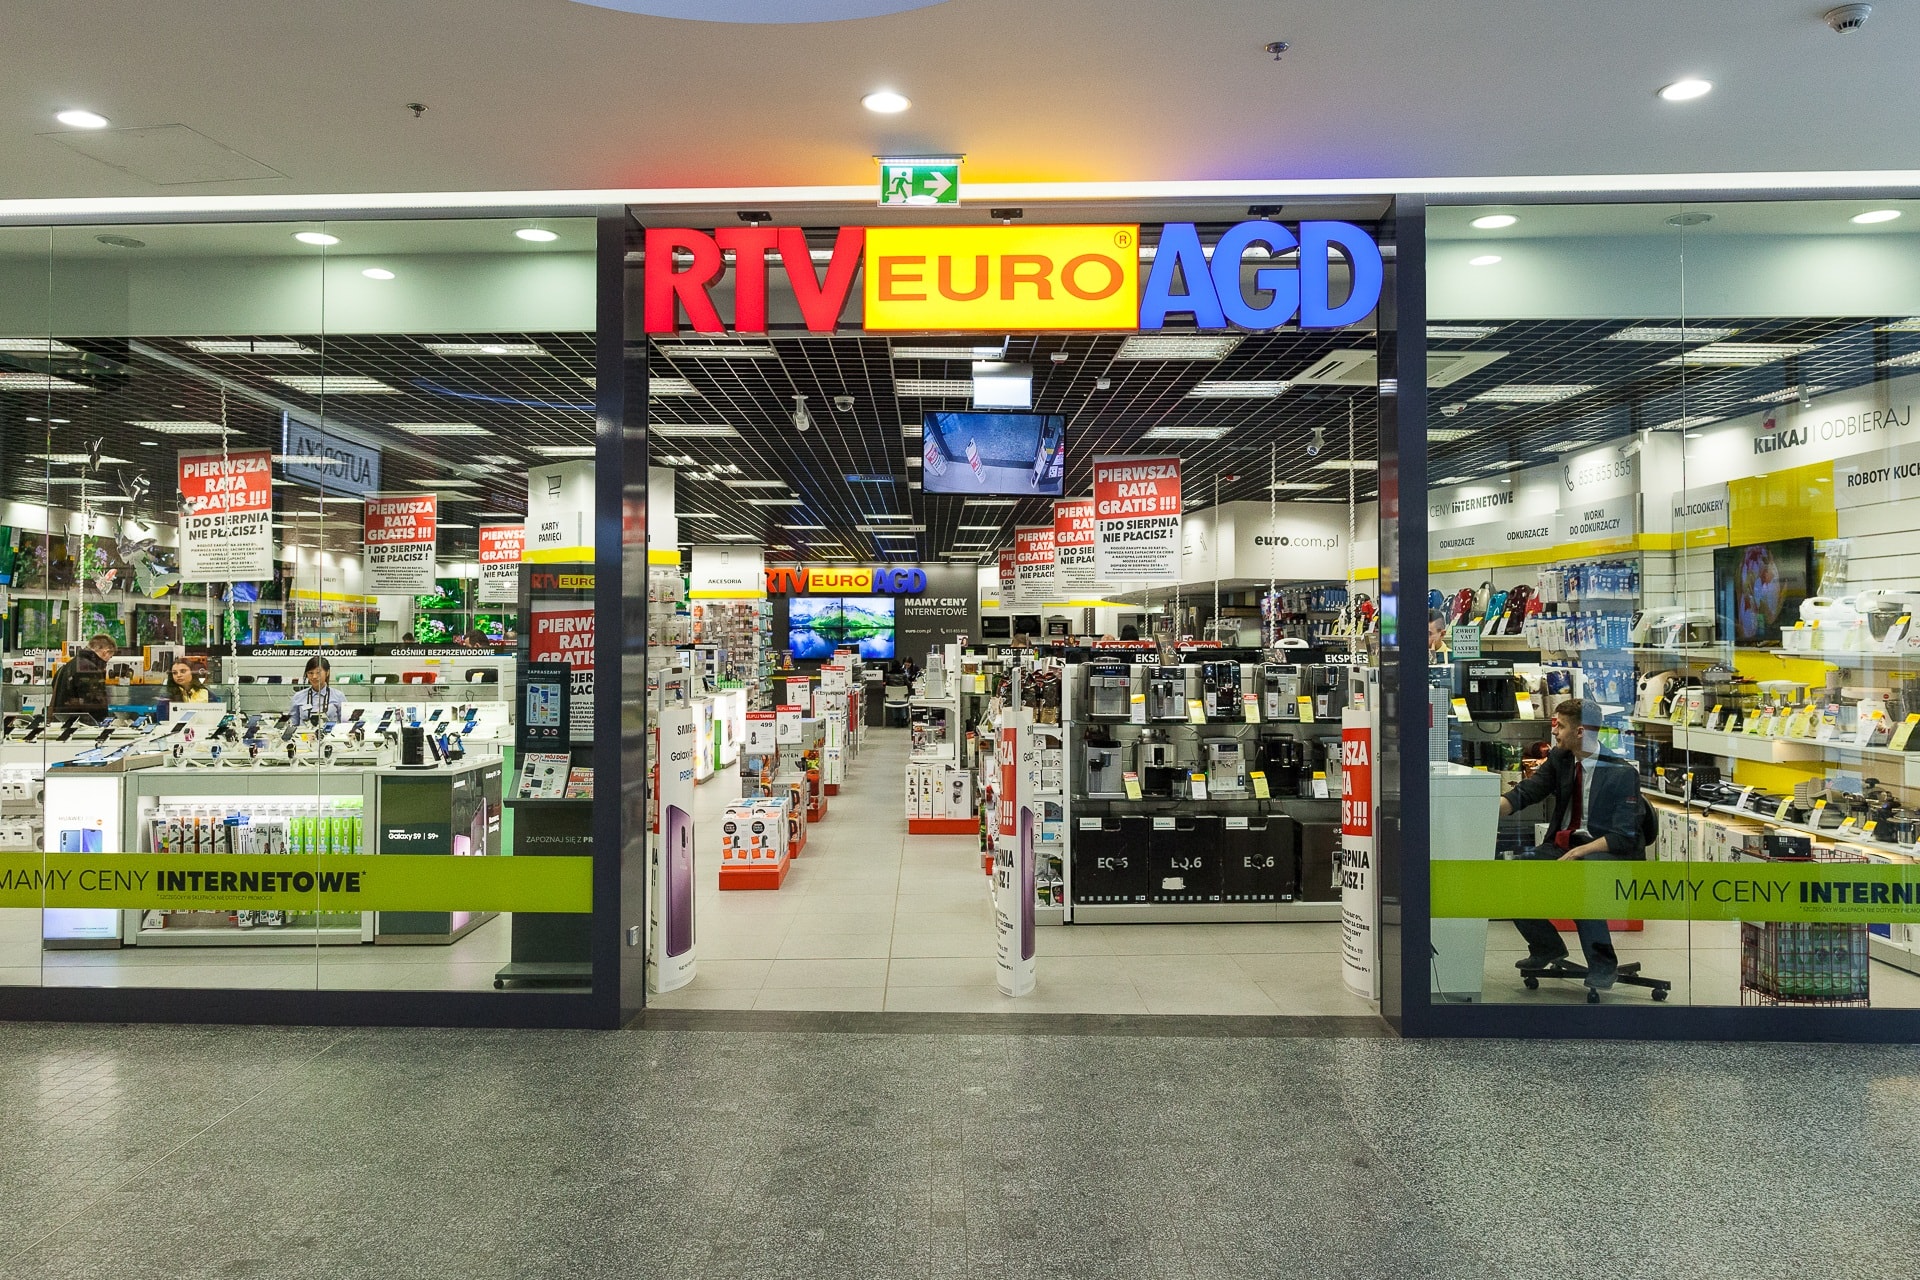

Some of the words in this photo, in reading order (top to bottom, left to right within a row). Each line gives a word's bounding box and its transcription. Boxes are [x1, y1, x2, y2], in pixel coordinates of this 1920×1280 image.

[644, 227, 864, 333] RTV
[878, 254, 1125, 302] EURO
[1138, 222, 1383, 331] AGD
[1821, 405, 1911, 441] ODBIERAJ
[183, 457, 269, 479] PIERWSZA
[1098, 464, 1178, 483] PIERWSZA
[1579, 468, 1593, 486] 855
[1596, 464, 1611, 481] 855
[1615, 459, 1631, 478] 855
[204, 475, 248, 493] RATA
[1847, 467, 1890, 488] ROBOTY
[1118, 482, 1158, 498] RATA
[368, 501, 433, 515] PIERWSZA
[1098, 497, 1156, 515] GRATIS
[1160, 496, 1177, 511] !!!
[1430, 503, 1450, 518] CENY
[1452, 491, 1514, 514] INTERNETOWE
[384, 515, 417, 528] RATA
[1584, 509, 1605, 521] WORKI
[193, 517, 212, 528] DO
[541, 521, 559, 532] KARTY
[1106, 521, 1124, 532] DO
[1126, 517, 1179, 530] SIERPNIA
[1569, 526, 1579, 535] DO
[1580, 518, 1621, 534] ODKURZACZY
[189, 529, 208, 541] NIE
[367, 527, 415, 542] GRATIS
[418, 526, 431, 538] !!!
[538, 532, 562, 543] PAMIĘCI
[1103, 533, 1121, 543] NIE
[1123, 529, 1166, 542] PŁACISZ
[1506, 527, 1549, 541] ODKURZACZE
[373, 545, 388, 554] DO
[390, 543, 433, 554] SIERPNIA
[494, 540, 520, 550] RATA
[1254, 534, 1339, 550] euro.com.pl
[1439, 537, 1475, 549] ODKURZACZE
[370, 554, 385, 563] NIE
[386, 552, 423, 563] PŁACISZ
[481, 550, 519, 561] GRATIS
[1017, 551, 1054, 562] GRATIS
[1060, 557, 1075, 565] NIE
[531, 573, 560, 589] RTV
[764, 568, 809, 593] RTV
[811, 574, 869, 587] EURO
[872, 567, 927, 593] AGD
[904, 598, 938, 606] MAMY
[940, 598, 968, 606] CENY
[904, 608, 968, 616] INTERNETOWE
[252, 648, 288, 657] GŁOŚNIKI
[289, 648, 357, 657] BEZPRZEWODOWE
[391, 648, 426, 657] GŁOŚNIKI
[427, 648, 496, 656] BEZPRZEWODOWE
[388, 832, 413, 841] Galaxy
[565, 836, 576, 844] SIĘ
[78, 869, 150, 892] CENY
[1615, 878, 1704, 901] MAMY
[1712, 879, 1791, 903] CENY
